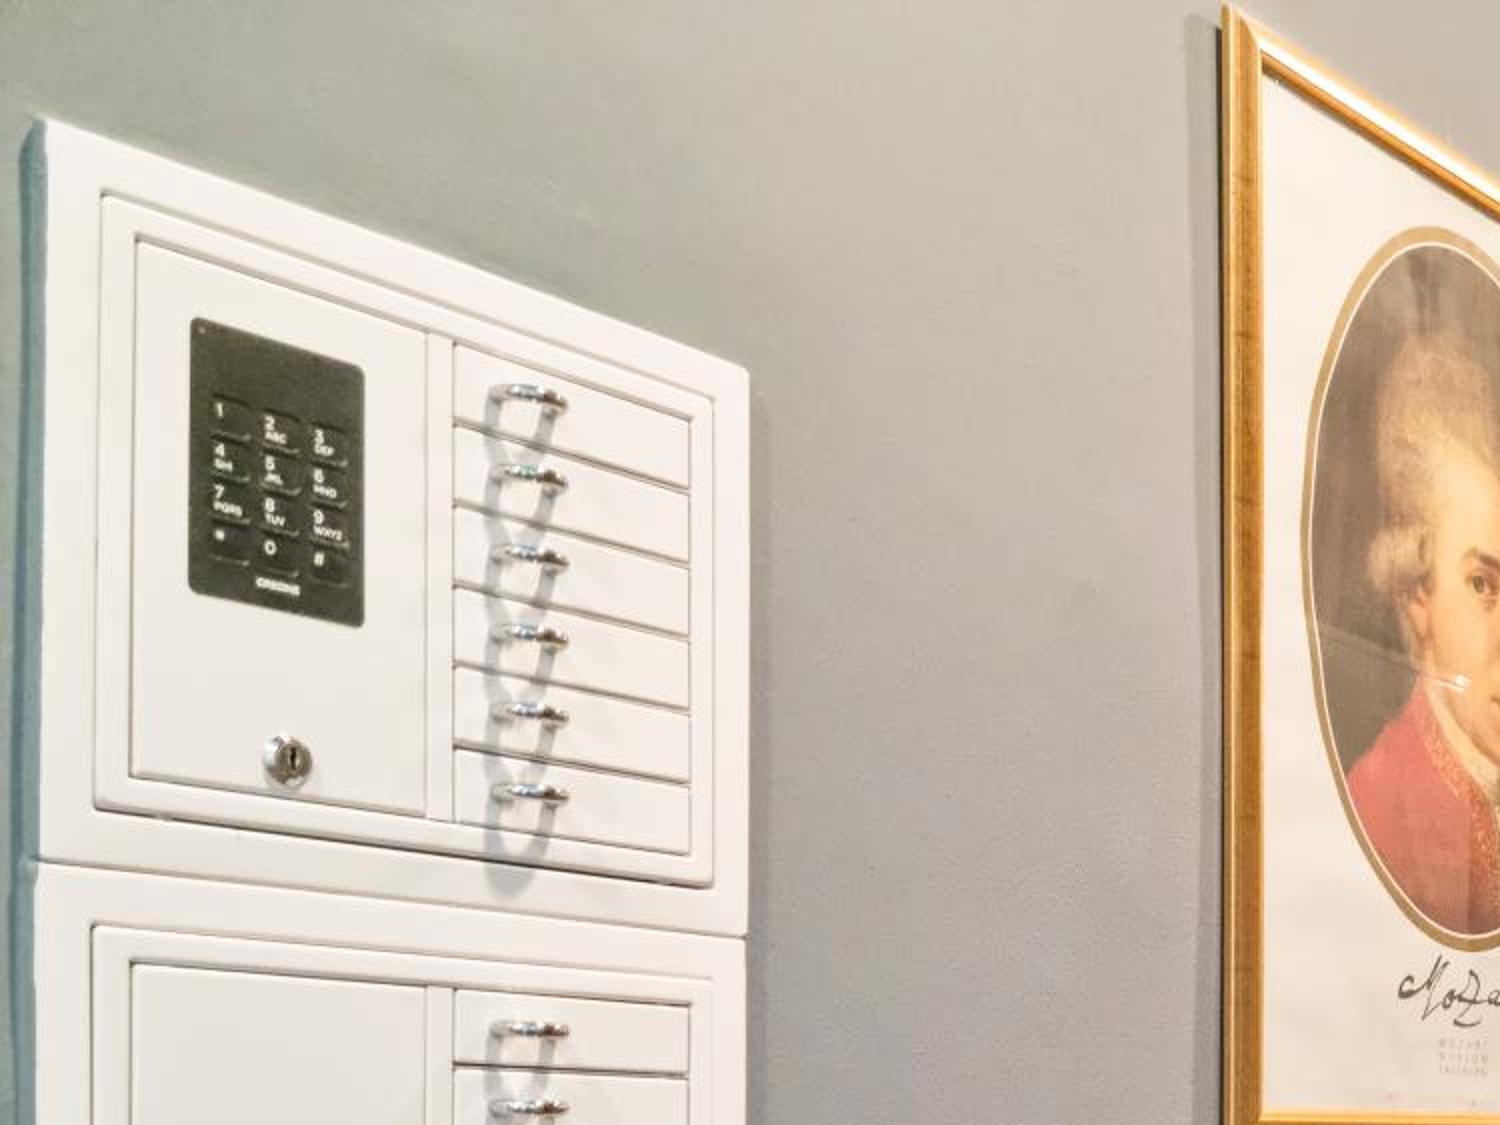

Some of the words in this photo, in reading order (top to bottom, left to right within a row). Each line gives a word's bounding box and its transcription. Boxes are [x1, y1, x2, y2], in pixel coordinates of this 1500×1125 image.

[215, 403, 223, 417] 1
[264, 415, 275, 431] 2
[314, 429, 324, 444] 3
[214, 443, 225, 457] 4
[265, 455, 275, 471] 5
[313, 468, 324, 484] 6
[214, 484, 225, 499] 7
[265, 498, 275, 513] 8
[265, 512, 286, 526] TUV
[313, 510, 324, 525] 9
[264, 540, 277, 556] 0
